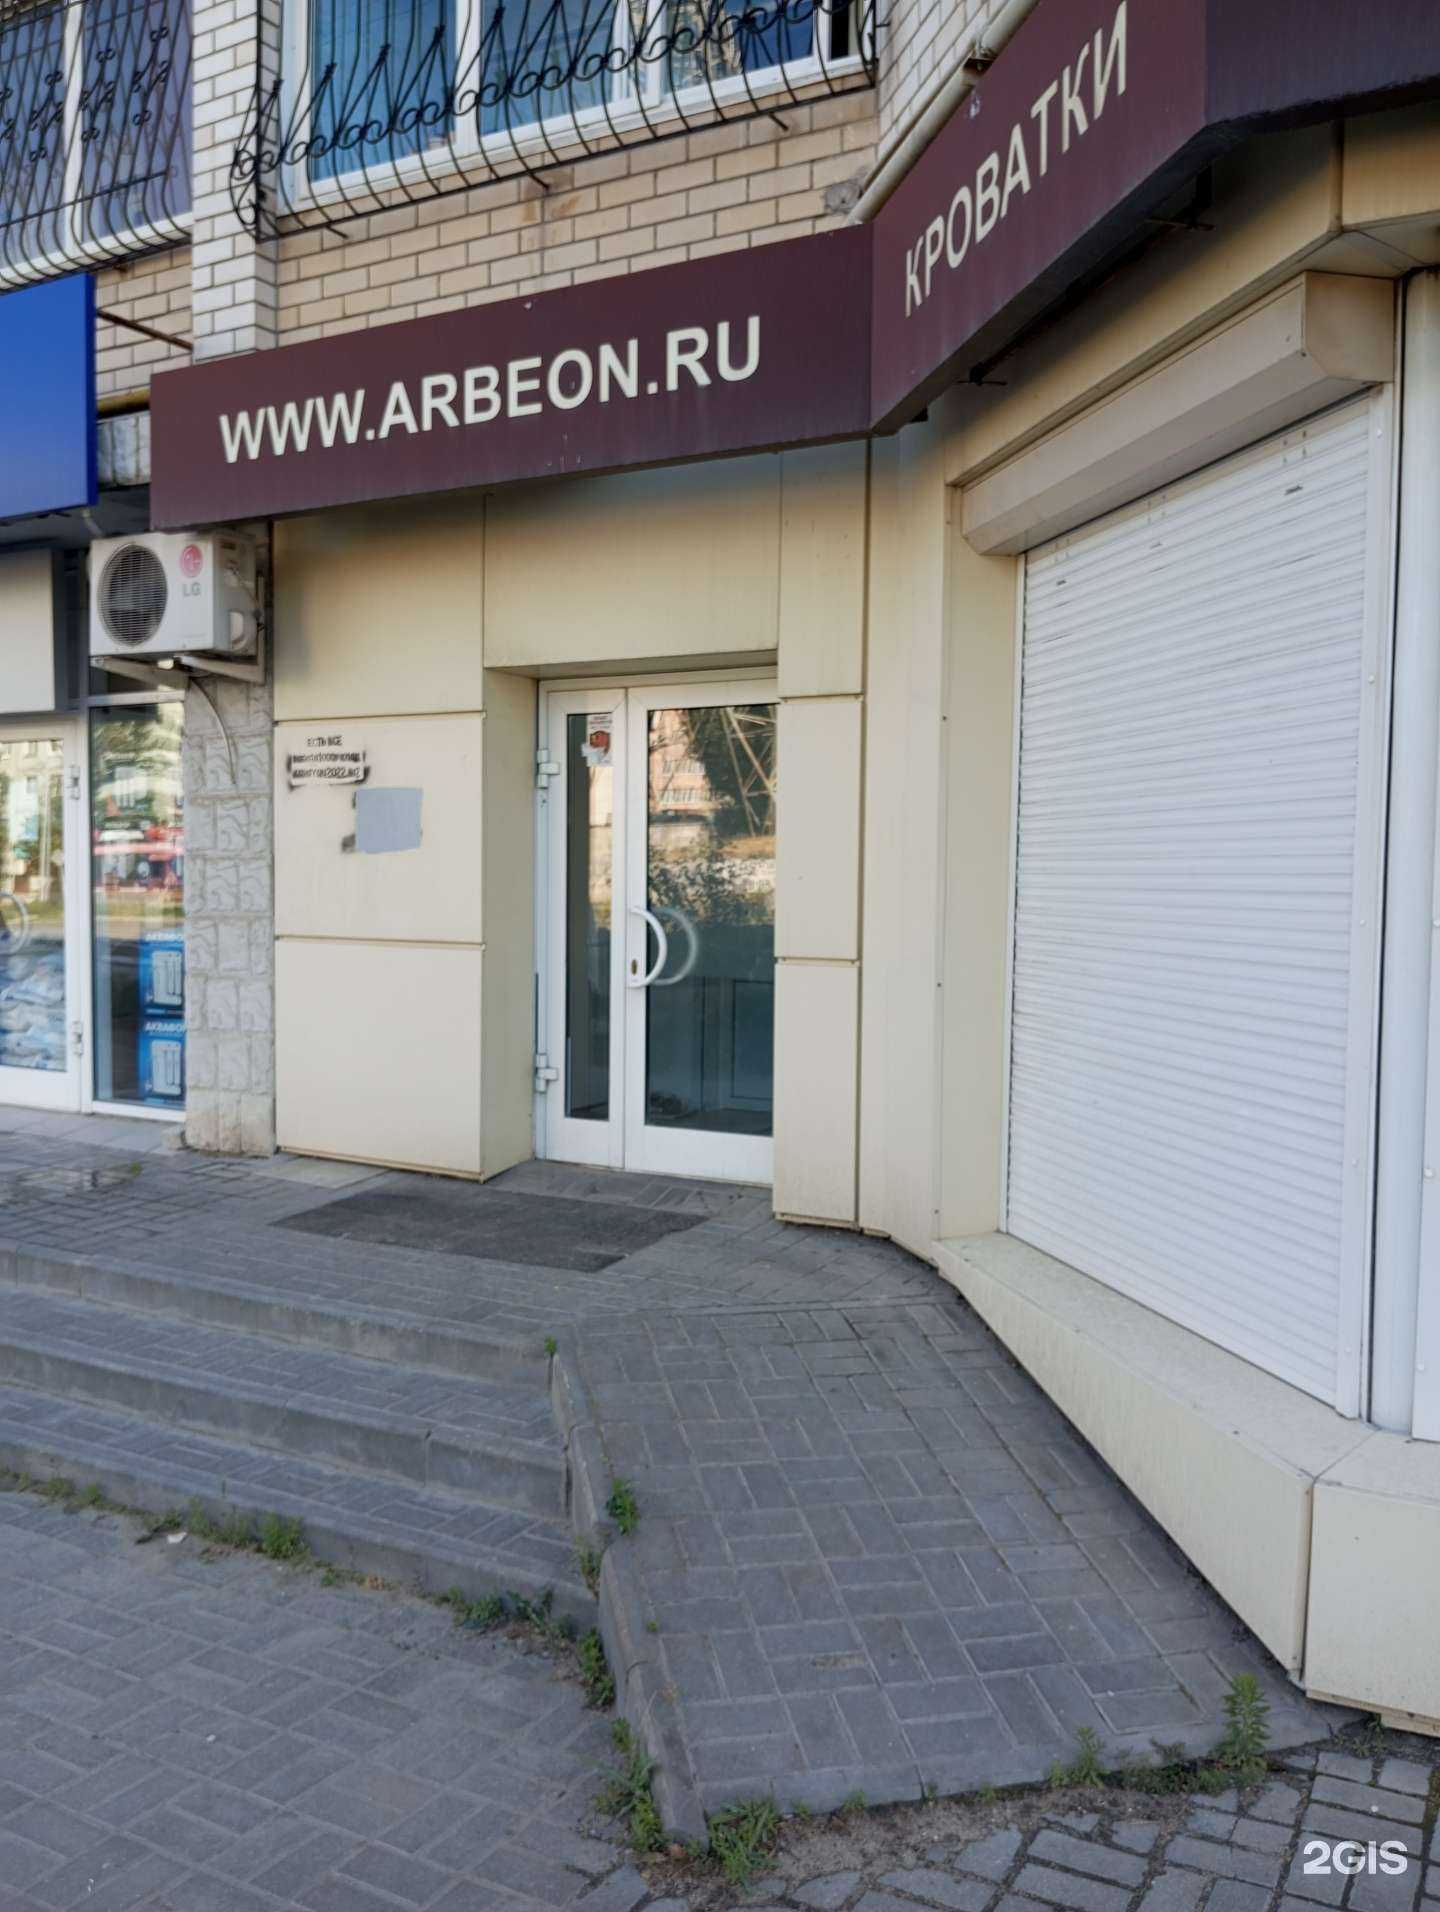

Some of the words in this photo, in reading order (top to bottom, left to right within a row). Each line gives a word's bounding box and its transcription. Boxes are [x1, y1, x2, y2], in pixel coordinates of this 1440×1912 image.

[904, 1, 1128, 318] КРОВАТКИ
[218, 314, 762, 465] WWW.ARBEON.RU
[182, 583, 202, 598] LG
